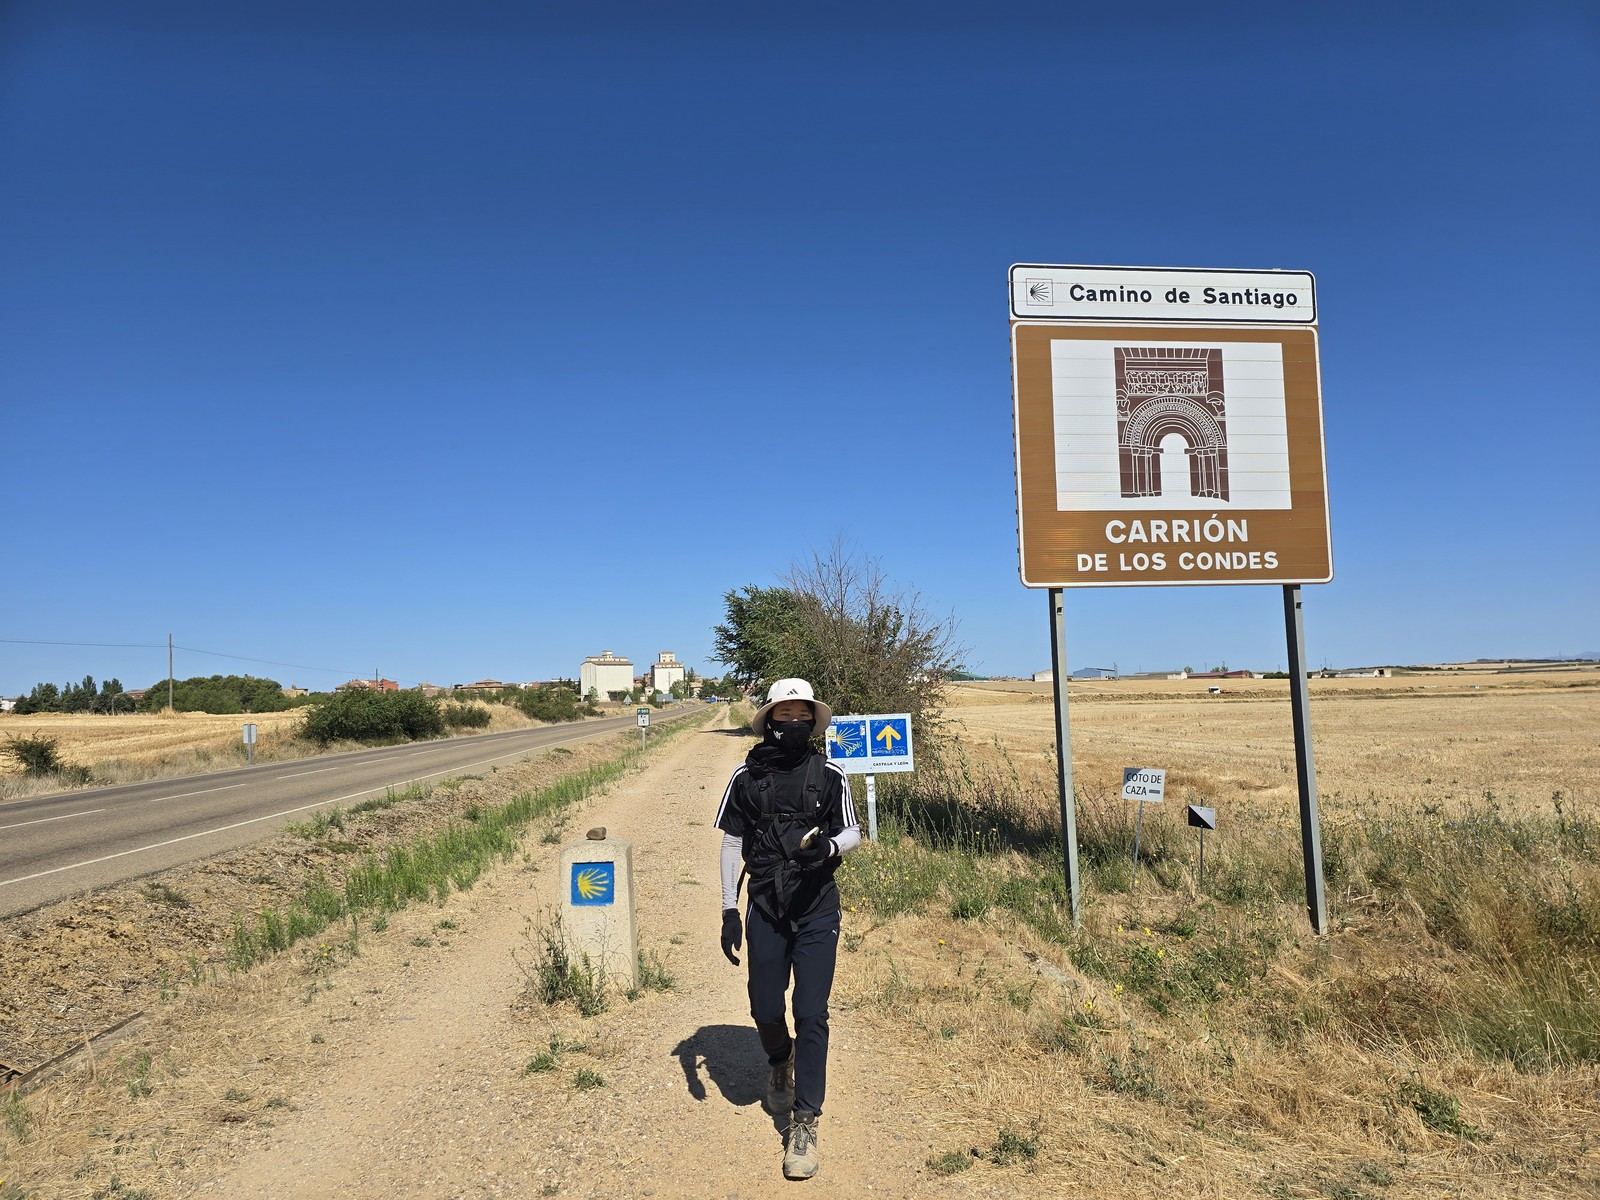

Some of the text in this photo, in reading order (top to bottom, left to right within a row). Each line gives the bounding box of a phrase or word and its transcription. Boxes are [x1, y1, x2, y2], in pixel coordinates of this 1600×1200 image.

[1069, 284, 1298, 309] Camino de Santiago
[1105, 513, 1248, 544] CARRIÓN
[1077, 551, 1279, 572] DE LOS CONDES
[1126, 773, 1161, 784] COTO DE
[1126, 785, 1147, 795] CAZA
